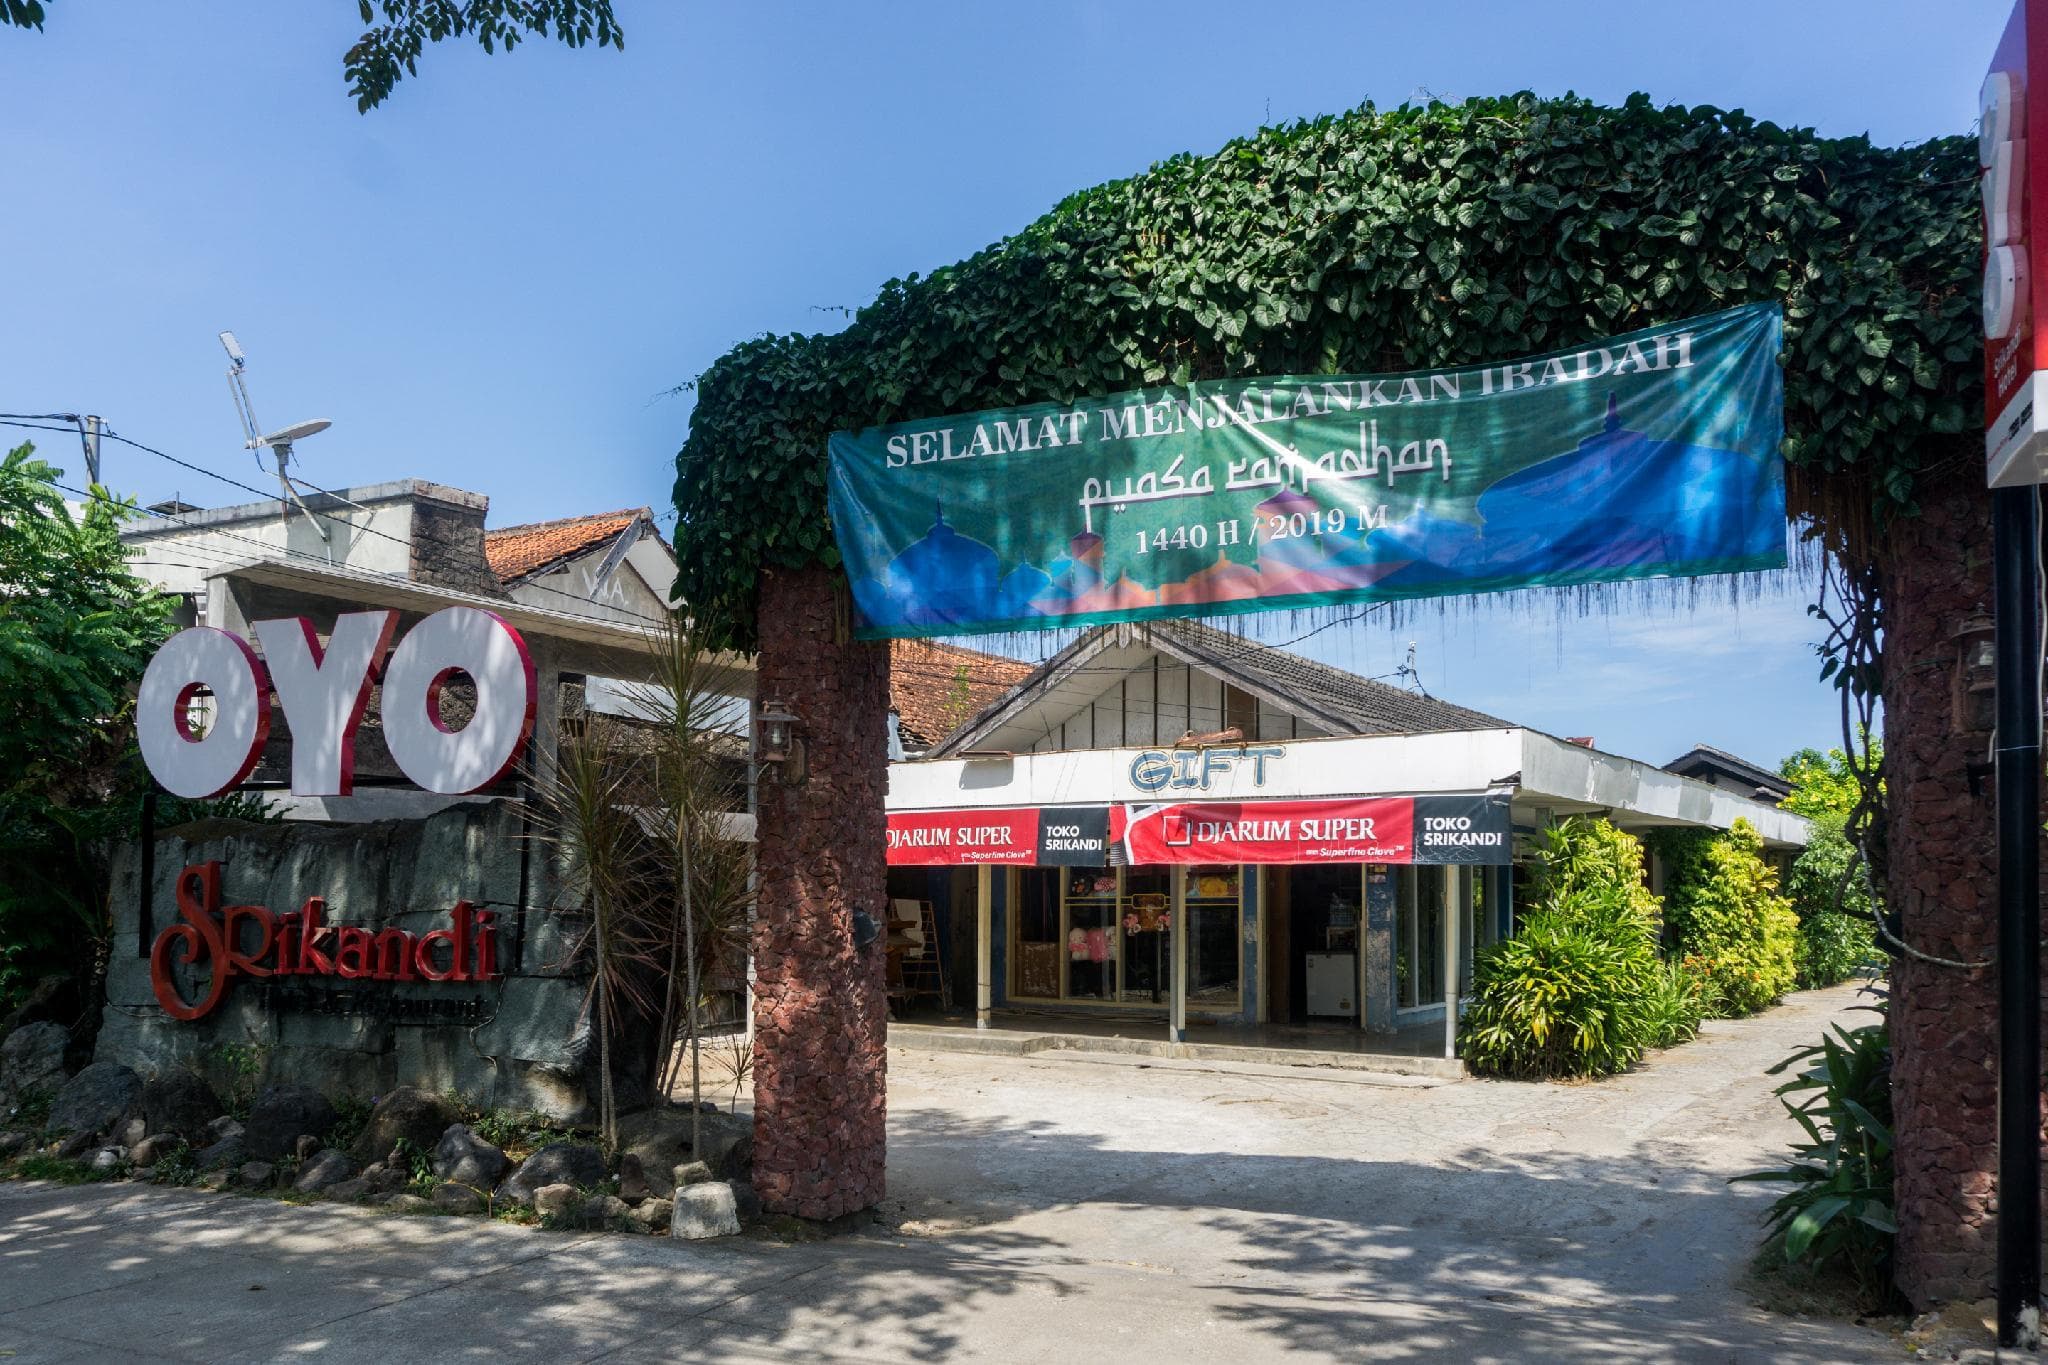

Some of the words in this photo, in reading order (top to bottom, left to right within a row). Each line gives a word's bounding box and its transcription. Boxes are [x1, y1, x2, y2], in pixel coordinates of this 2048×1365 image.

[885, 410, 1089, 469] SELAMAT
[1098, 373, 1461, 443] MENJALANKAN
[1481, 331, 1697, 397] IBADAH
[1135, 522, 1208, 555] 1440
[1217, 519, 1240, 547] H
[1247, 515, 1261, 546] /
[1270, 509, 1343, 542] 2019
[1355, 503, 1390, 531] M
[136, 605, 538, 799] OYO
[1127, 744, 1286, 792] GIFT
[1046, 825, 1080, 838] TOKO
[1197, 820, 1292, 845] DJARUM
[1298, 817, 1377, 841] SUPER
[1423, 816, 1471, 831] TOKO
[956, 826, 1014, 846] SUPER
[1045, 837, 1103, 851] SRIKANDI
[1423, 831, 1502, 846] SRIKANDI
